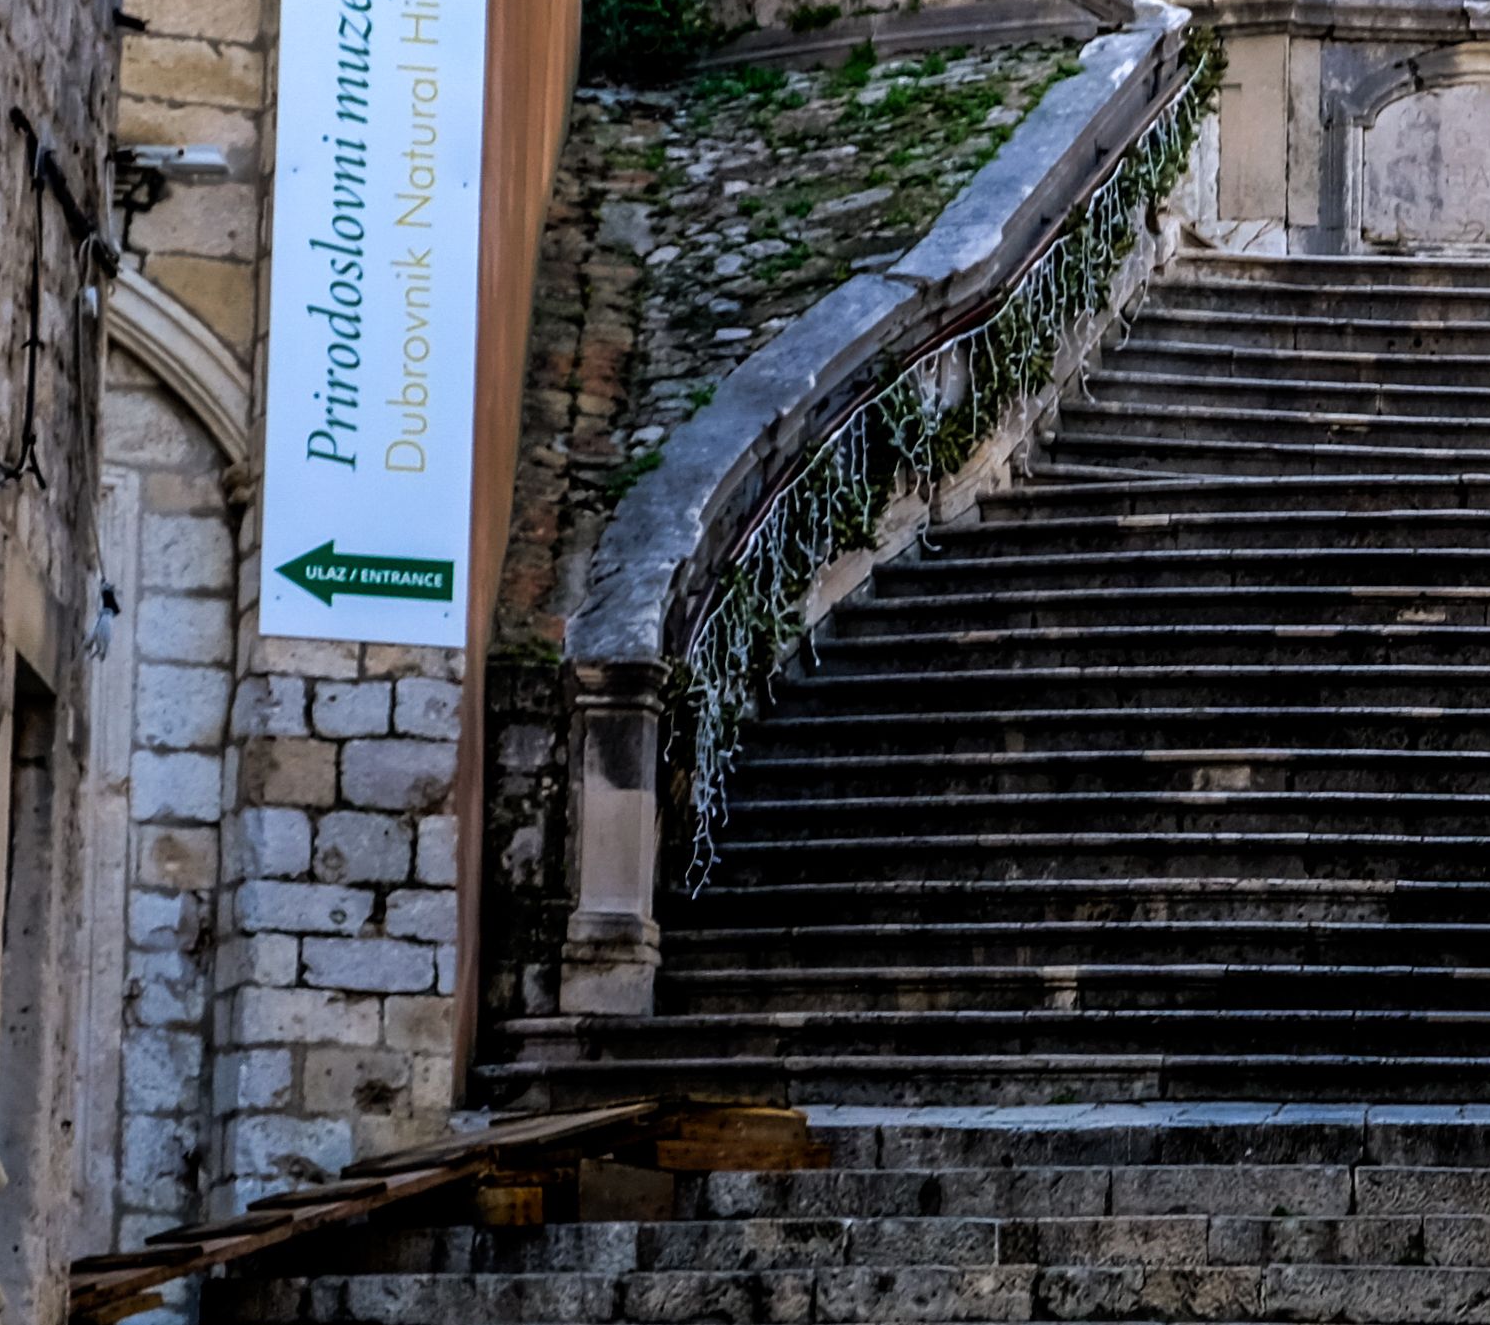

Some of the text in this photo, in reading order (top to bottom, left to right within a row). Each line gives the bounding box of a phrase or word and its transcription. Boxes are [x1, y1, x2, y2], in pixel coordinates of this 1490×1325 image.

[394, 65, 439, 227] Natural
[306, 135, 367, 472] Prirodoslovni
[384, 246, 433, 473] Dubrovnik
[305, 564, 347, 582] ULAZ
[359, 568, 444, 588] ENTRANCE
